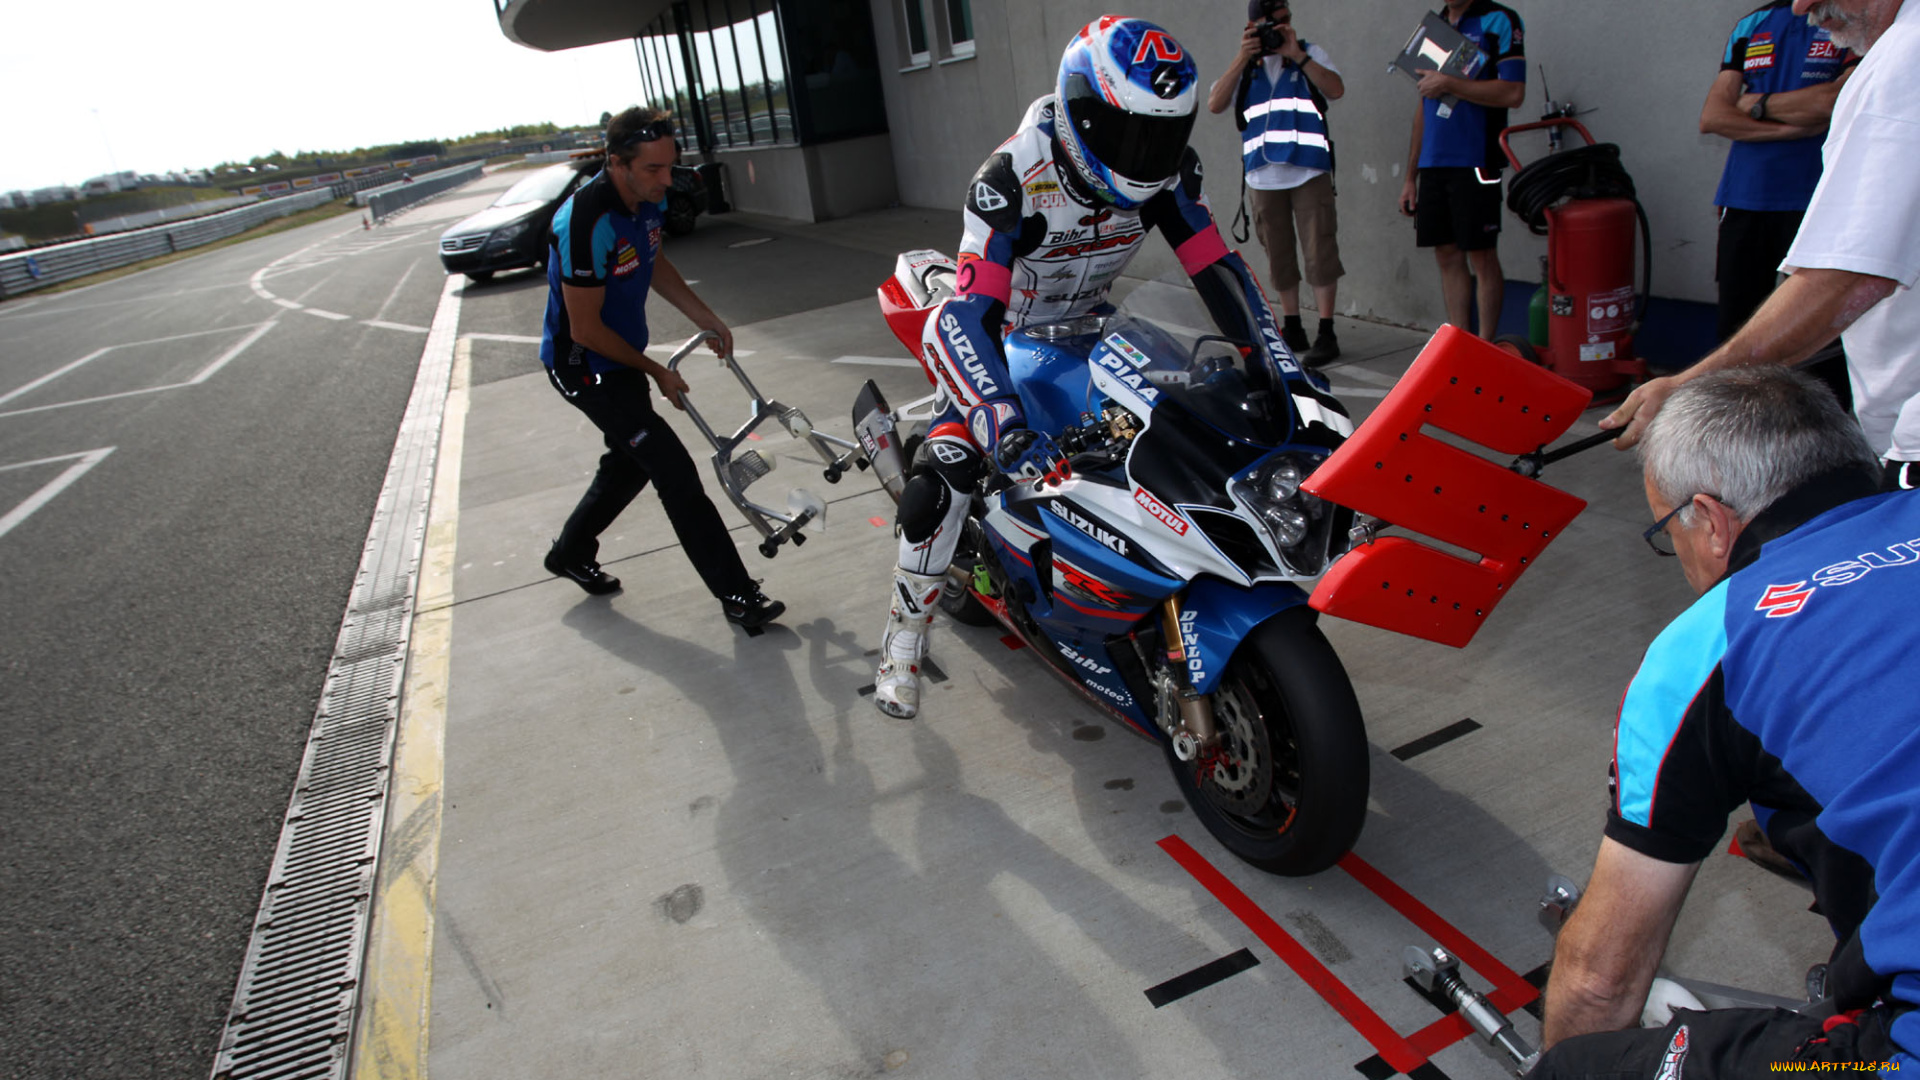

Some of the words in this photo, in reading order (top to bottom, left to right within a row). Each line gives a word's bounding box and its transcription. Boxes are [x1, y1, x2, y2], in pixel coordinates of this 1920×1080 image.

[1049, 229, 1088, 244] Bihr
[939, 313, 998, 396] SUZUKI
[1262, 328, 1299, 373] PIAA
[1099, 351, 1159, 402] PIAA
[1050, 499, 1127, 556] SUZUKI
[1135, 491, 1186, 534] MOTUL
[1057, 641, 1112, 676] Bihr
[1179, 610, 1205, 683] DUNLOP
